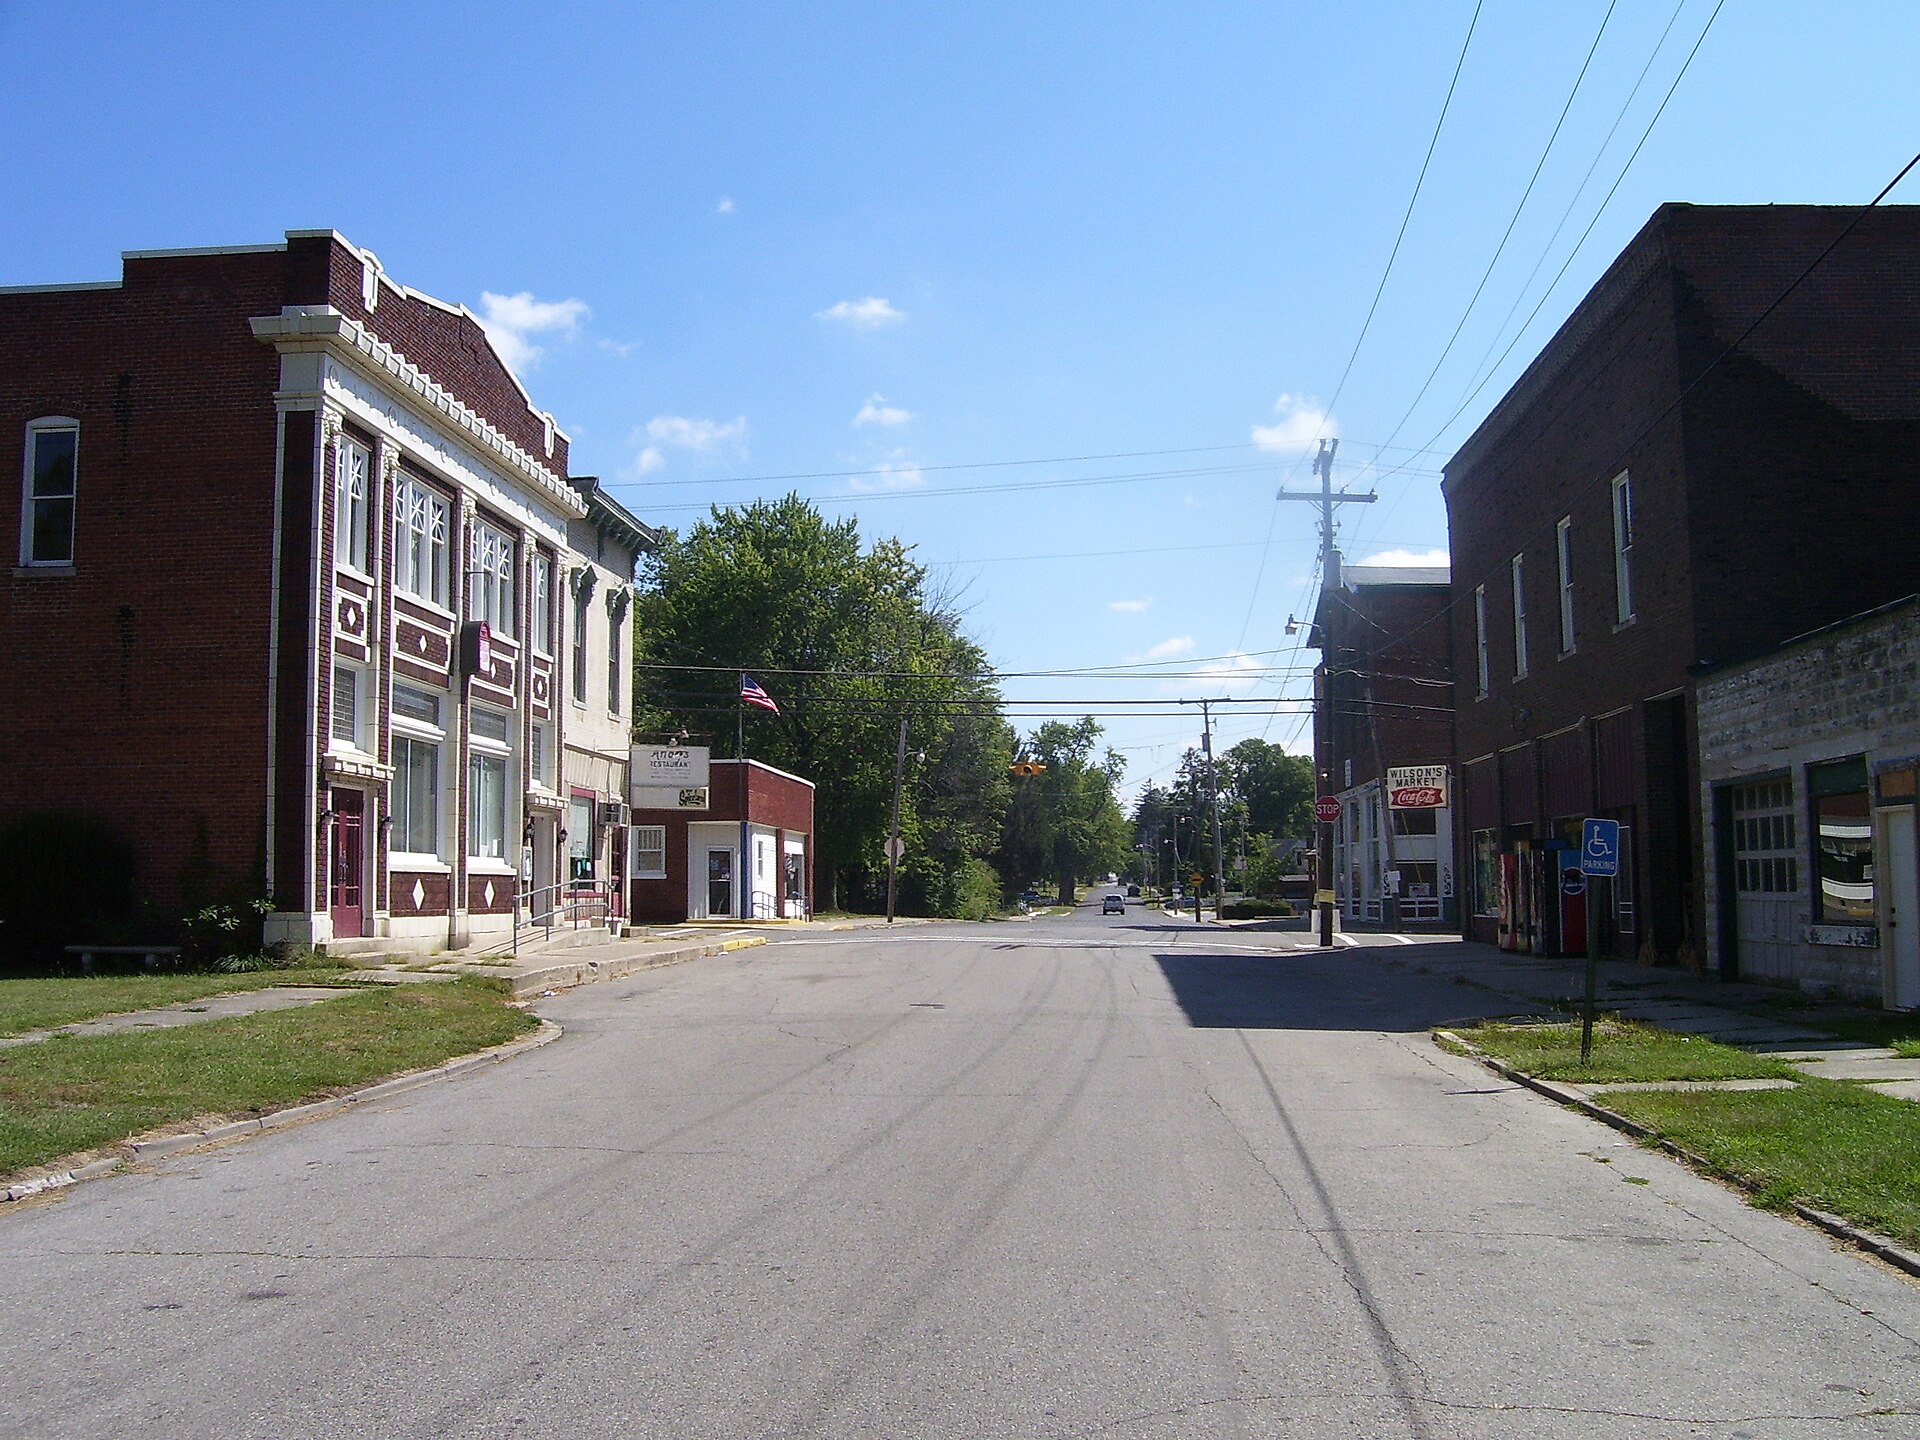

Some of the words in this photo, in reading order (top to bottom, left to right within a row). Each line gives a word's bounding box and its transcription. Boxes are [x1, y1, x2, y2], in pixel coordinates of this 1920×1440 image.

[1390, 767, 1443, 778] WILSON'S
[1396, 777, 1437, 788] MARKET
[1316, 804, 1340, 815] STOP
[1583, 859, 1615, 870] PARKING
